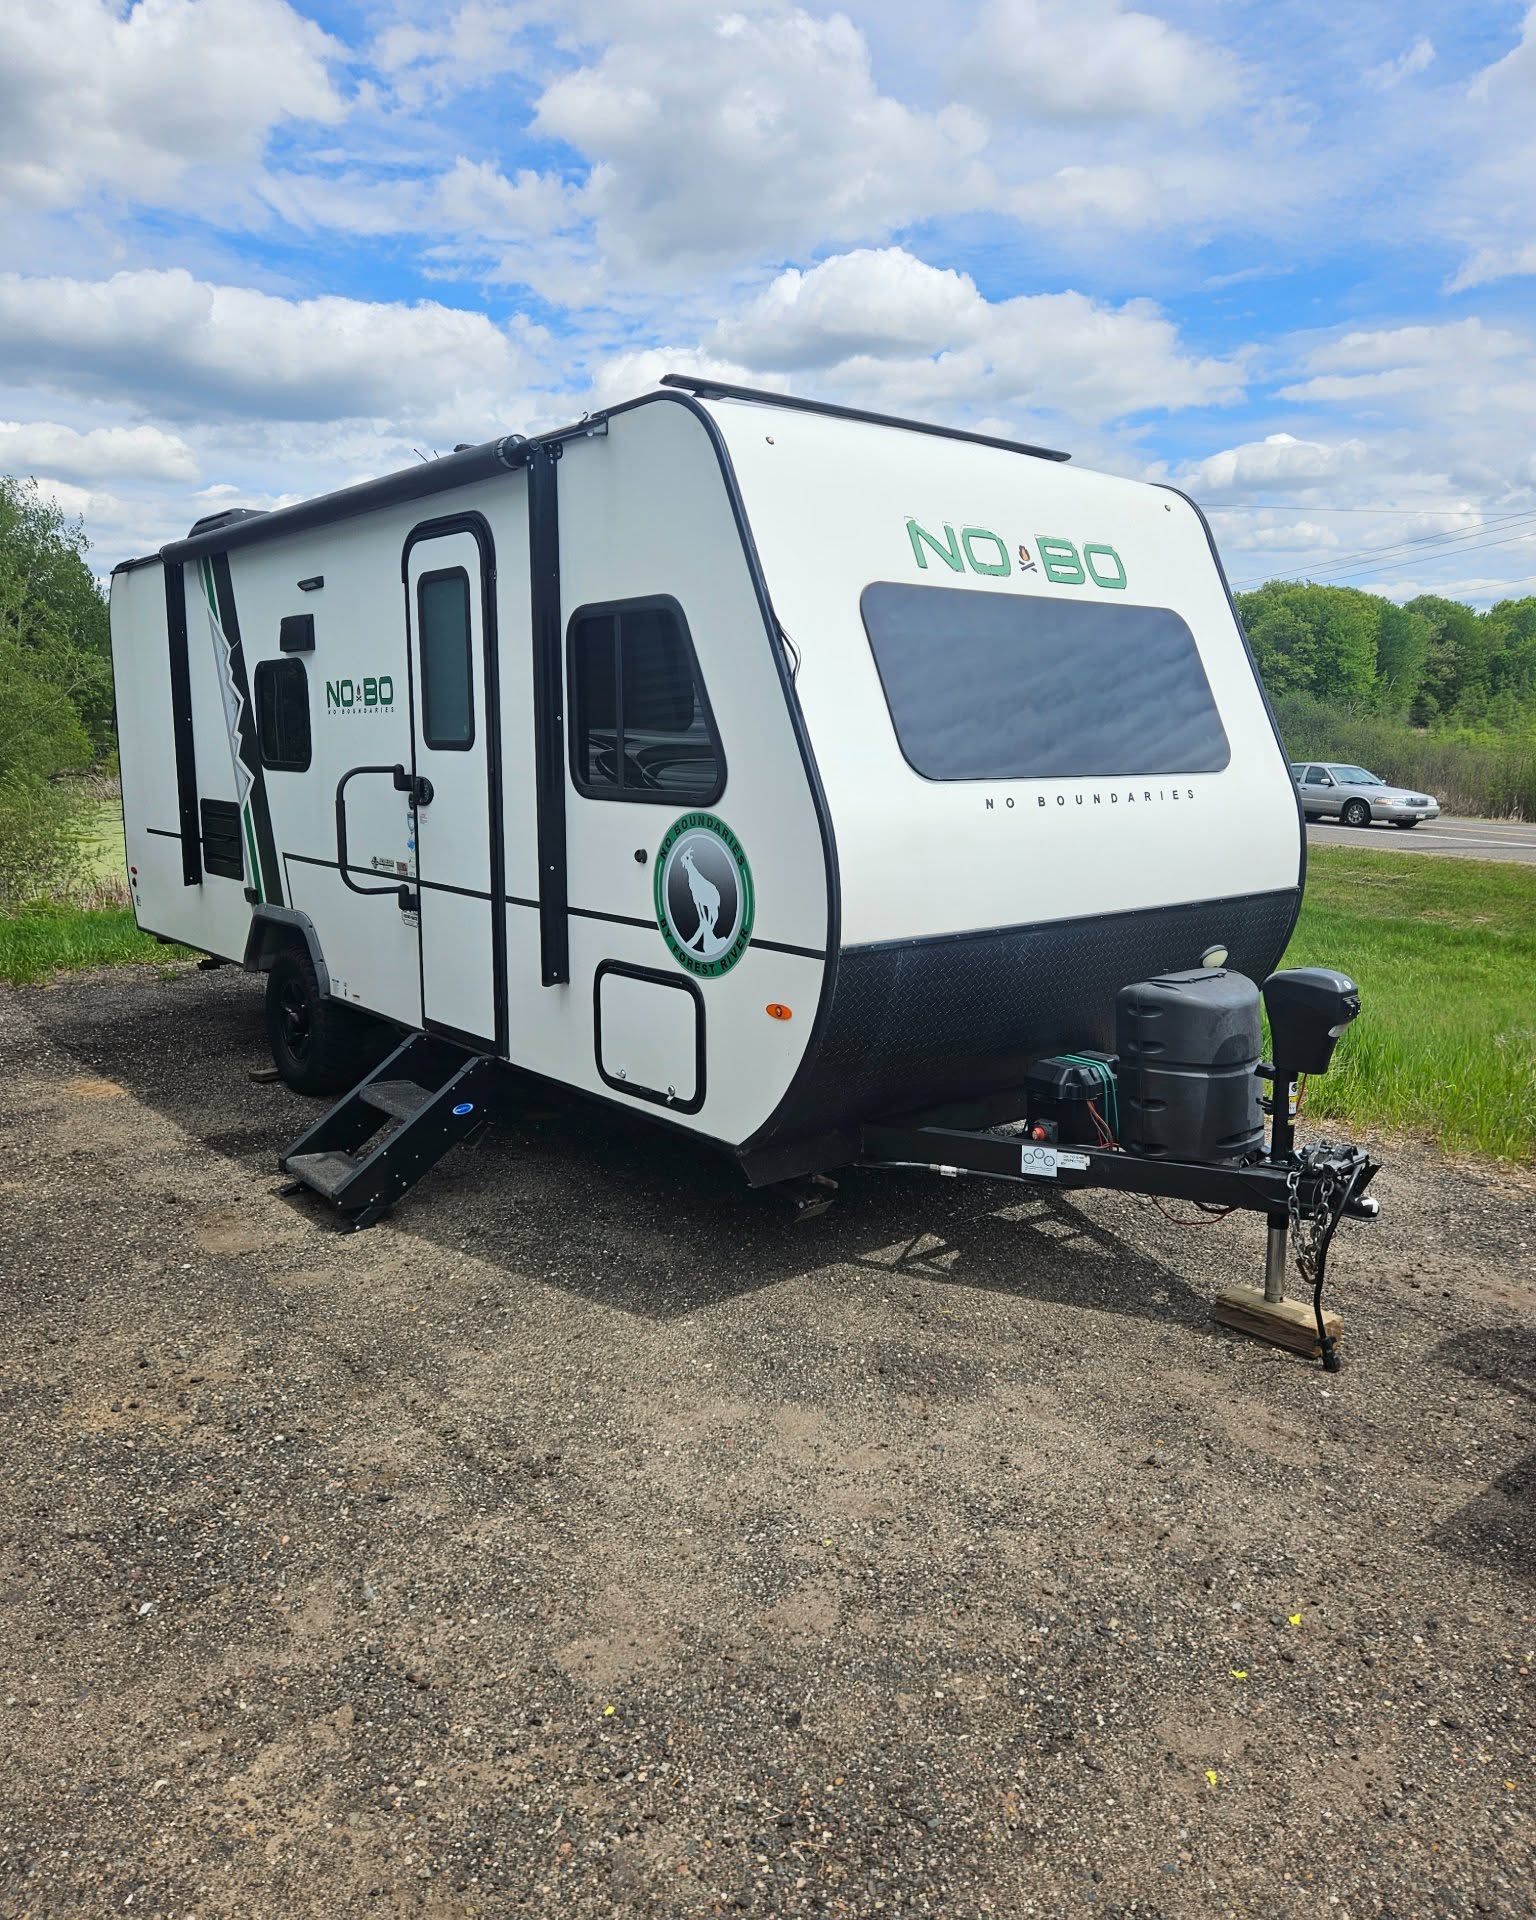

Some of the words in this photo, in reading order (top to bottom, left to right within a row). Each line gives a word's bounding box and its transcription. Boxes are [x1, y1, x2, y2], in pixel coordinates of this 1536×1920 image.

[985, 797, 1015, 810] NO
[1037, 788, 1195, 808] BOUNDARIES
[659, 839, 673, 860] NO
[674, 815, 746, 867] BOUNDARIES
[659, 917, 673, 939] BY
[673, 945, 715, 975] FOREST
[720, 928, 749, 971] RIVER
